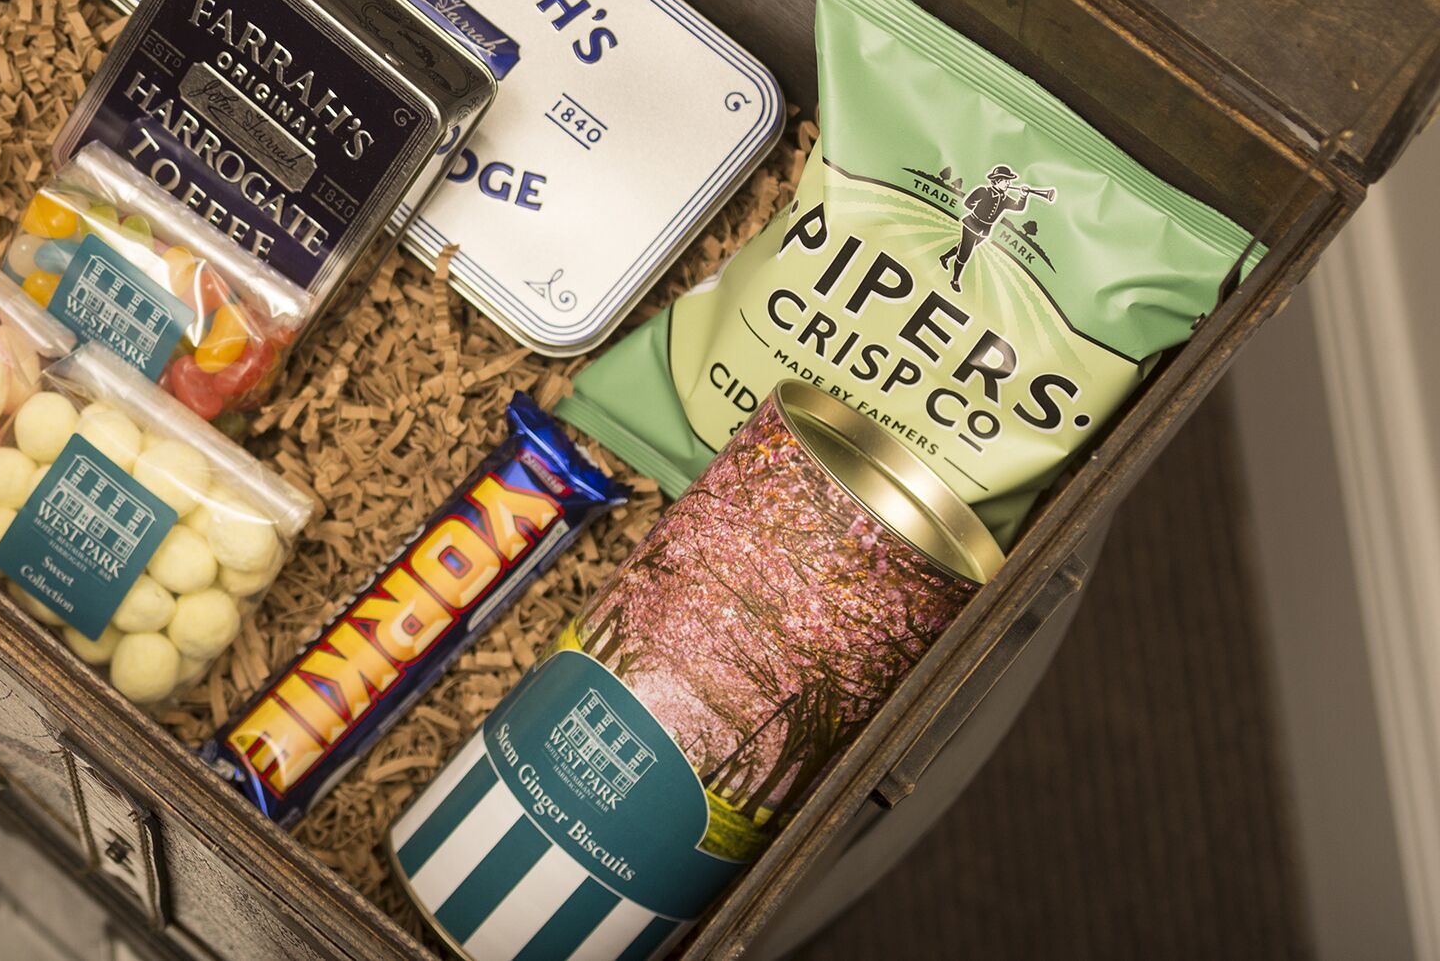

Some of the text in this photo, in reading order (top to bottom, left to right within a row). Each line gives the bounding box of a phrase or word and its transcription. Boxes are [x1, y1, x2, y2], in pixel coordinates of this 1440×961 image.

[216, 50, 317, 146] ORIGINAL
[551, 99, 603, 144] 1840
[123, 70, 330, 257] HARROGATE
[316, 181, 357, 219] 1840
[445, 147, 548, 212] DGE
[913, 178, 1038, 265] TRADE MARK
[66, 295, 110, 334] WEST
[108, 330, 151, 370] PARK
[766, 288, 923, 394] CRISP
[709, 361, 759, 414] CID
[773, 349, 940, 456] MADE BY FARMERS
[37, 500, 126, 579] WEST PARK
[41, 555, 75, 588] Sweet
[19, 564, 75, 614] Collection
[224, 472, 564, 801] YORKIE
[495, 722, 637, 882] Stem Ginger Biscuits
[544, 741, 561, 762] HOTEL
[595, 798, 610, 814] BAR
[549, 726, 623, 811] WEST PARK
